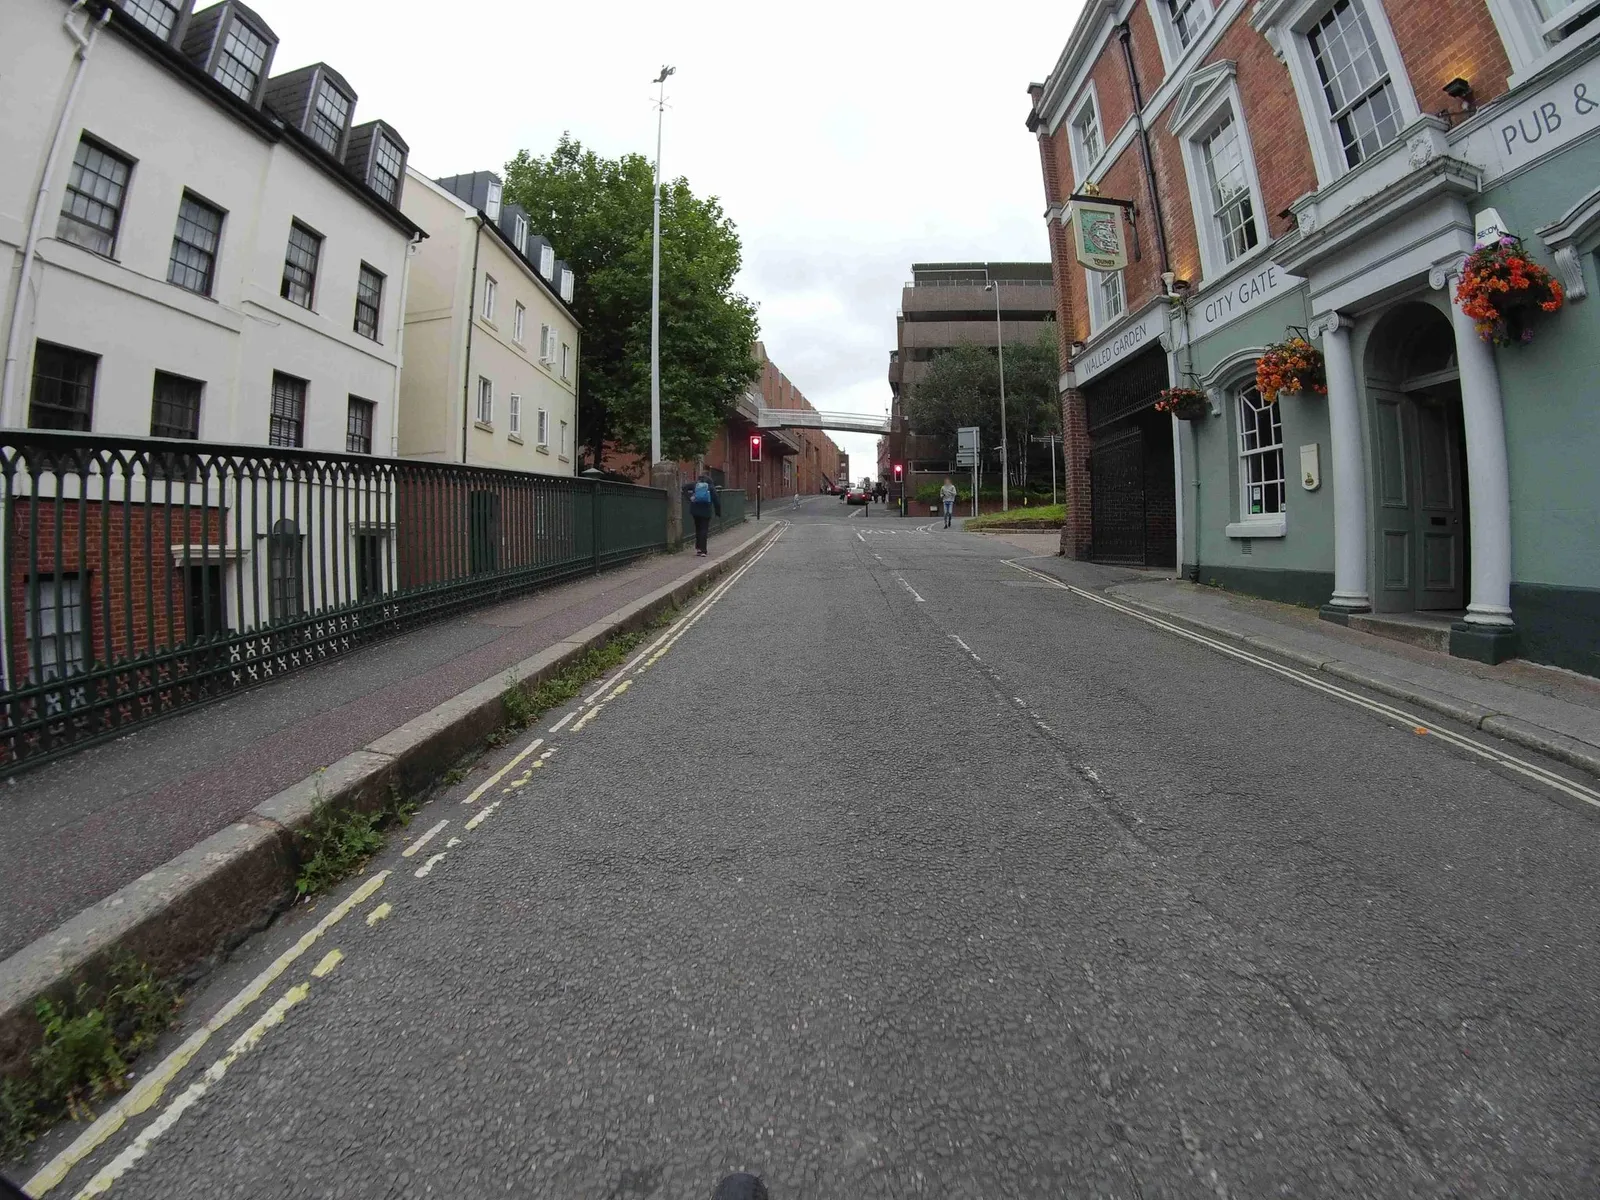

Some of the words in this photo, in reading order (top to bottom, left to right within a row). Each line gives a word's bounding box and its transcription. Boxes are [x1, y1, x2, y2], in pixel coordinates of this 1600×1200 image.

[1502, 102, 1561, 154] PUB
[1573, 83, 1599, 115] &
[1205, 291, 1233, 323] CITY
[1238, 266, 1277, 304] GATE
[1084, 347, 1111, 375] WALLED
[1113, 322, 1147, 356] GARDEN
